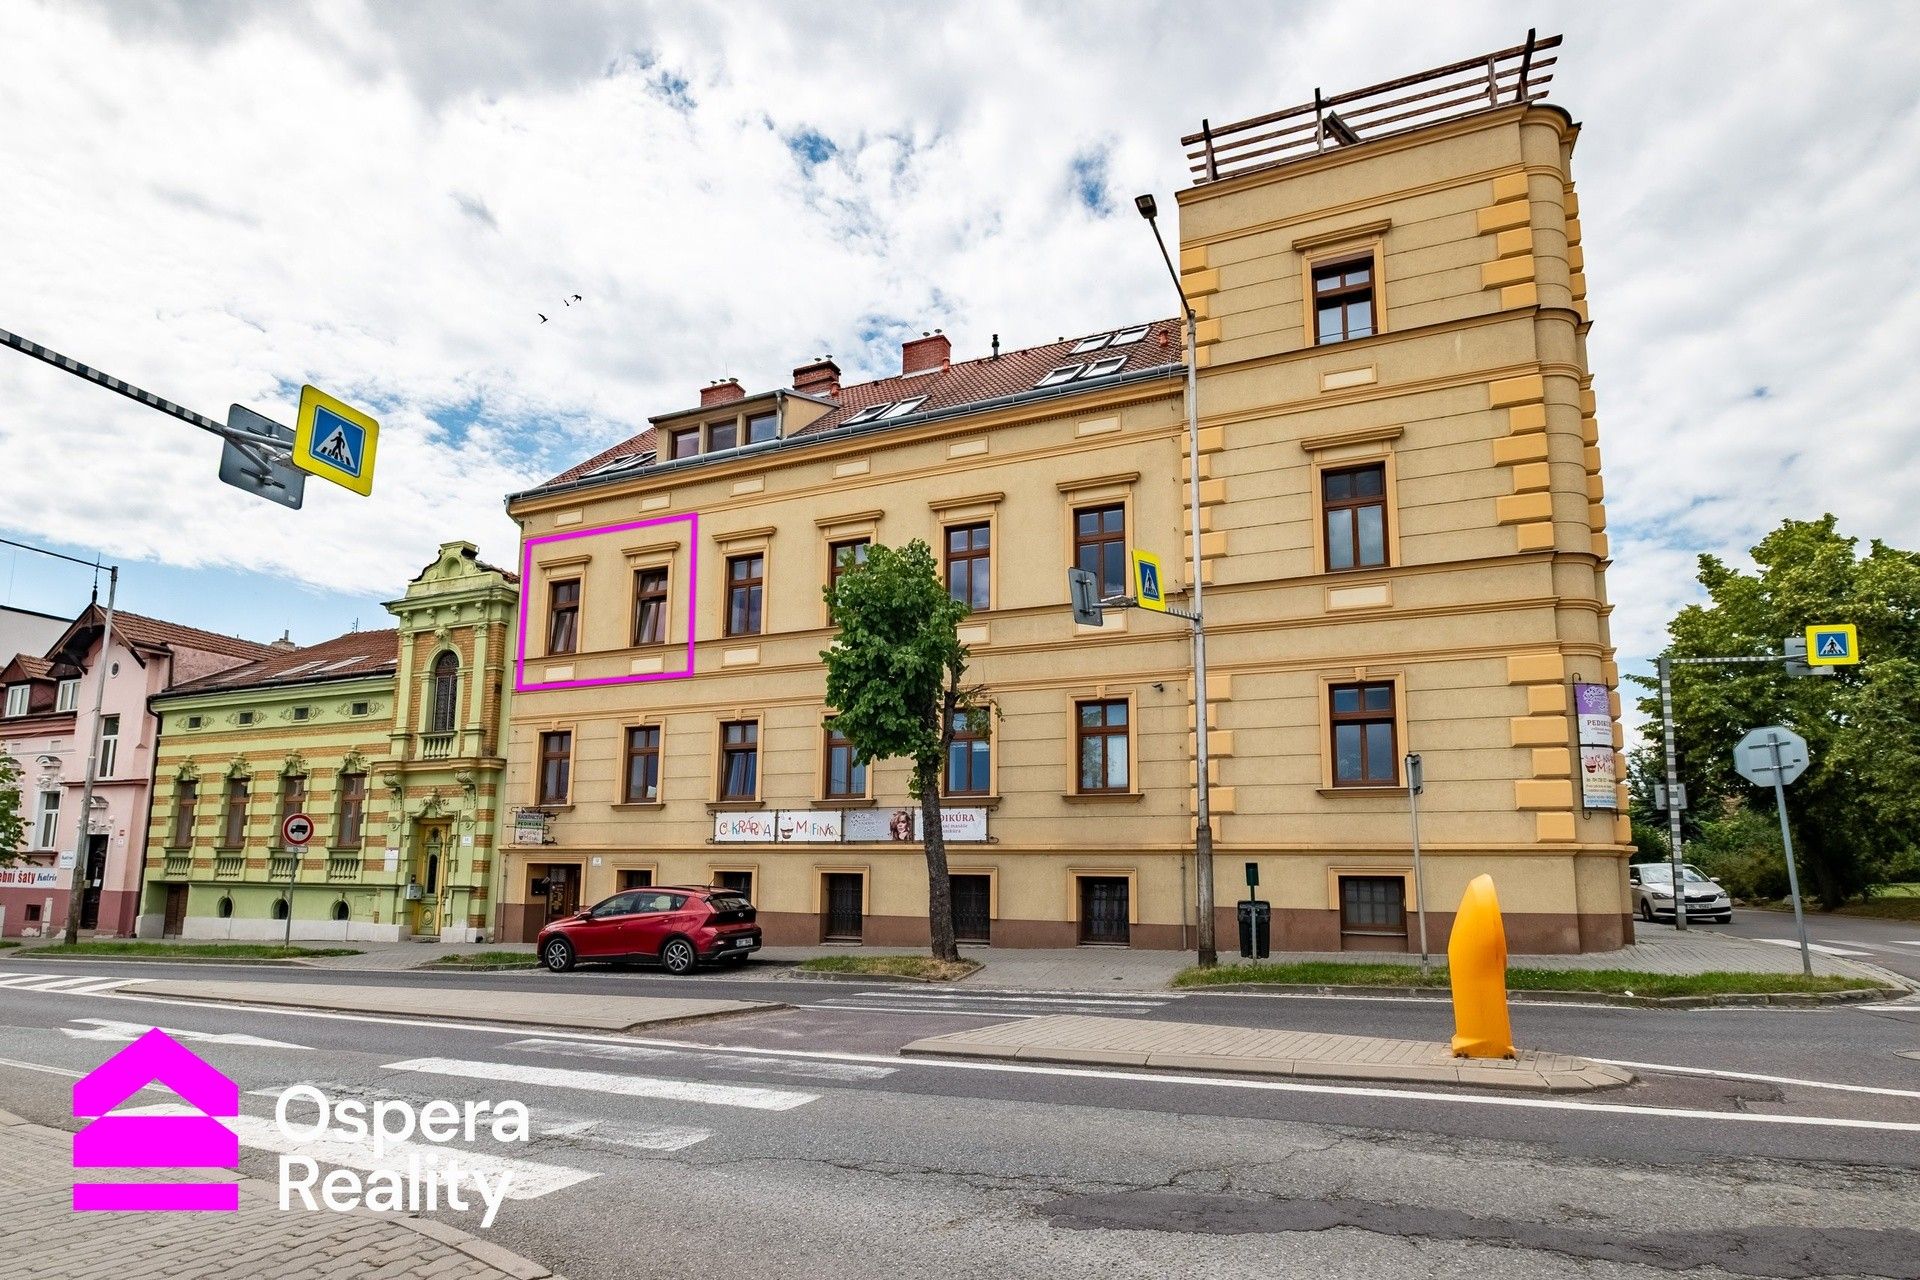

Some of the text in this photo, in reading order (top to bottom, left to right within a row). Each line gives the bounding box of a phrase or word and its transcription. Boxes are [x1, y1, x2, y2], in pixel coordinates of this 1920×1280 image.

[940, 812, 975, 822] DIKÚRA
[719, 816, 772, 837] CKRÁRA
[18, 870, 36, 884] šaty
